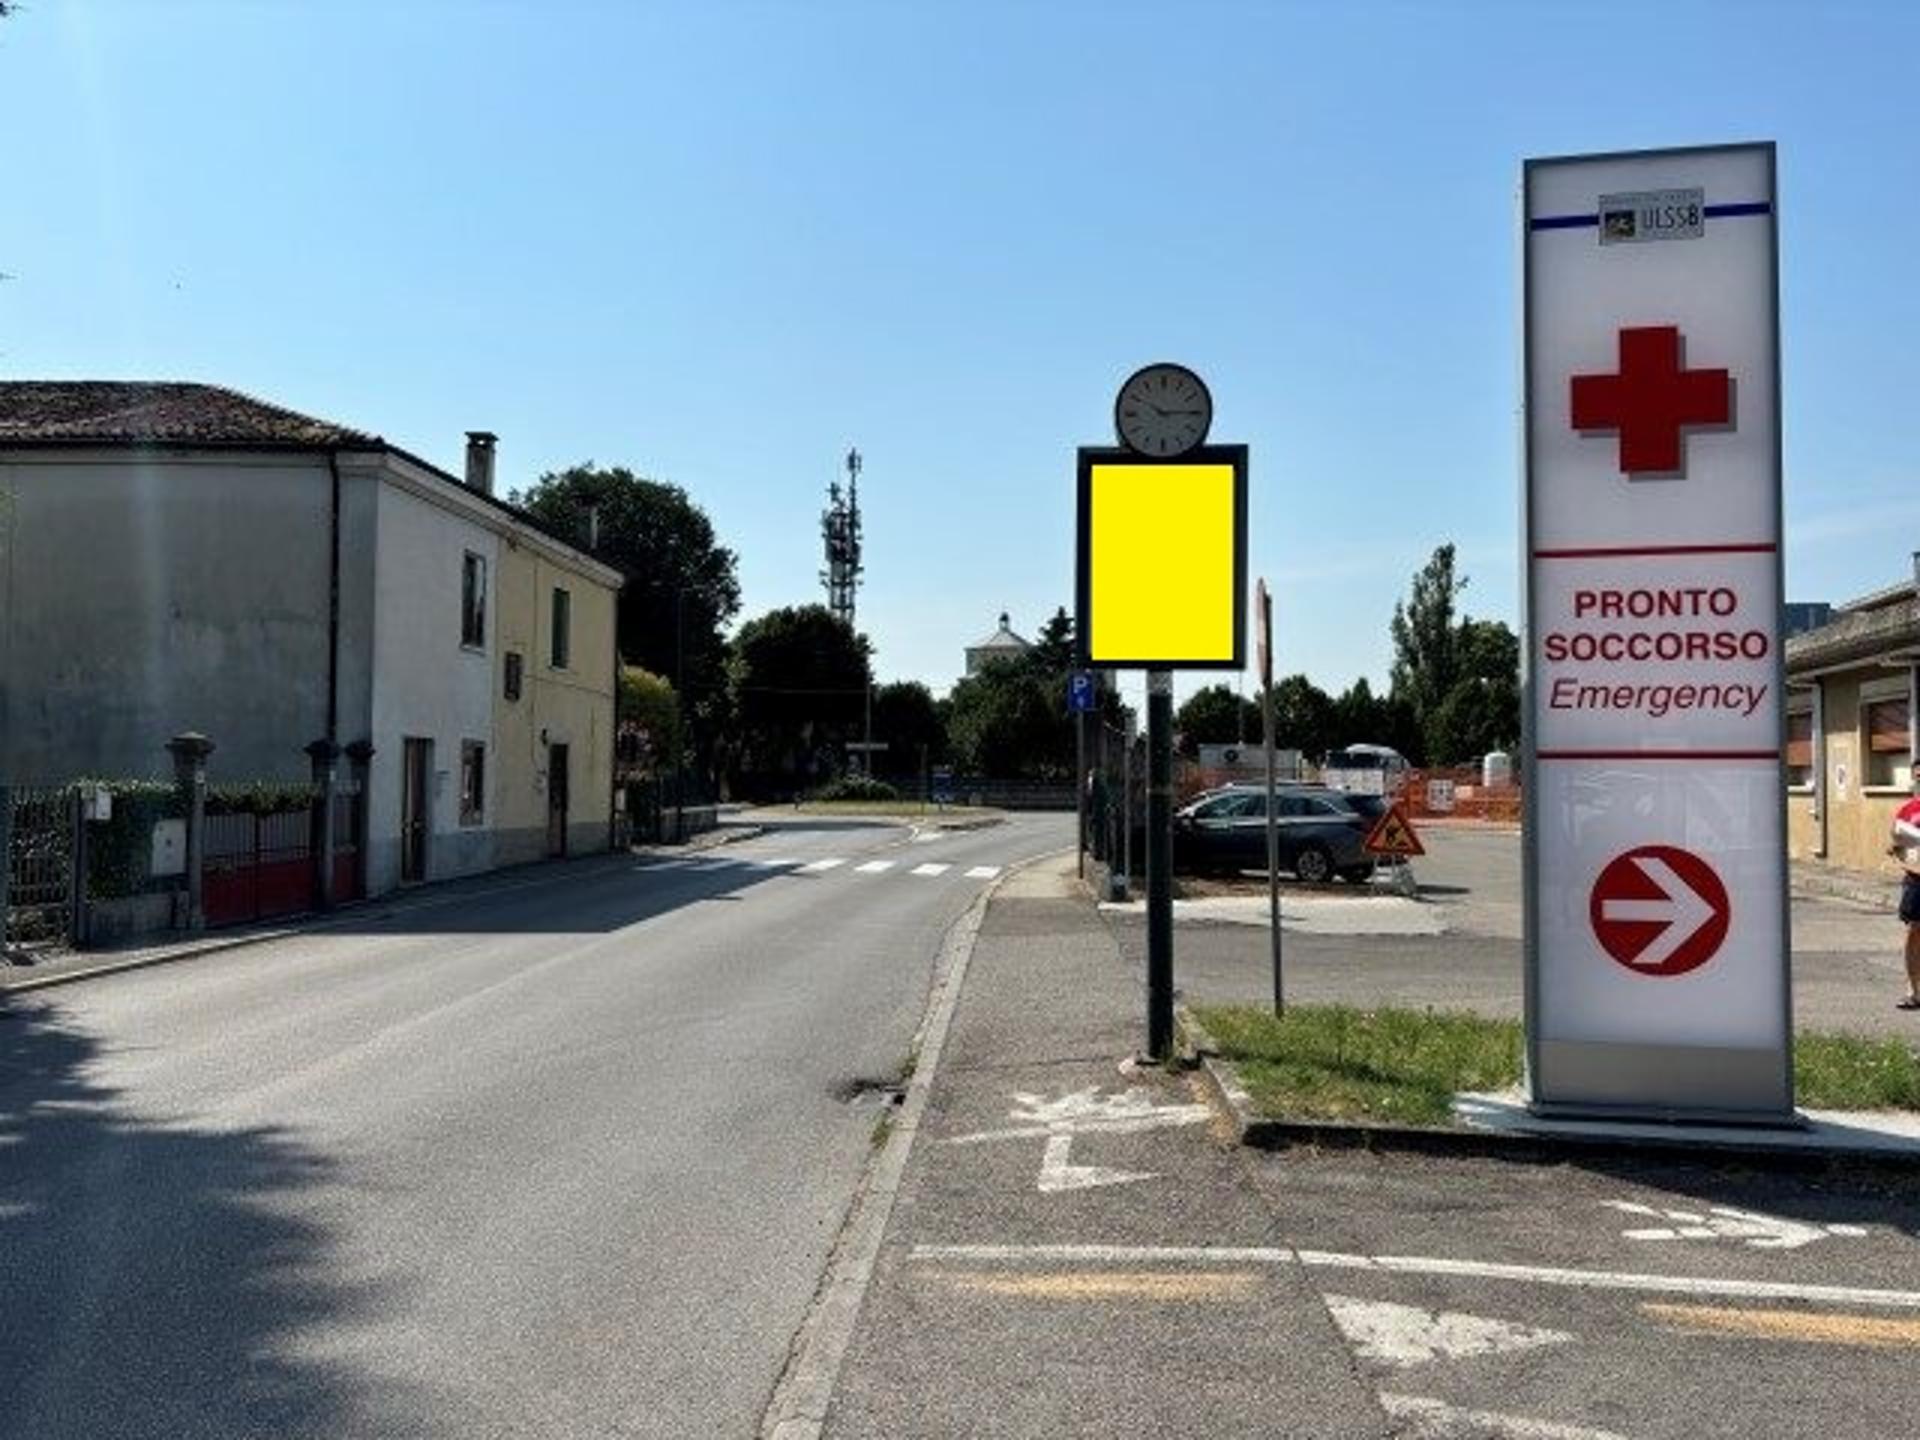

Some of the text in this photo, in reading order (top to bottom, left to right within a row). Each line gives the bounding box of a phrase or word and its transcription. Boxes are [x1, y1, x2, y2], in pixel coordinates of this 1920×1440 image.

[1574, 588, 1737, 618] PRONTO
[1545, 631, 1768, 661] SOCCORSO
[1073, 677, 1087, 693] P
[1550, 678, 1767, 718] Emergency
